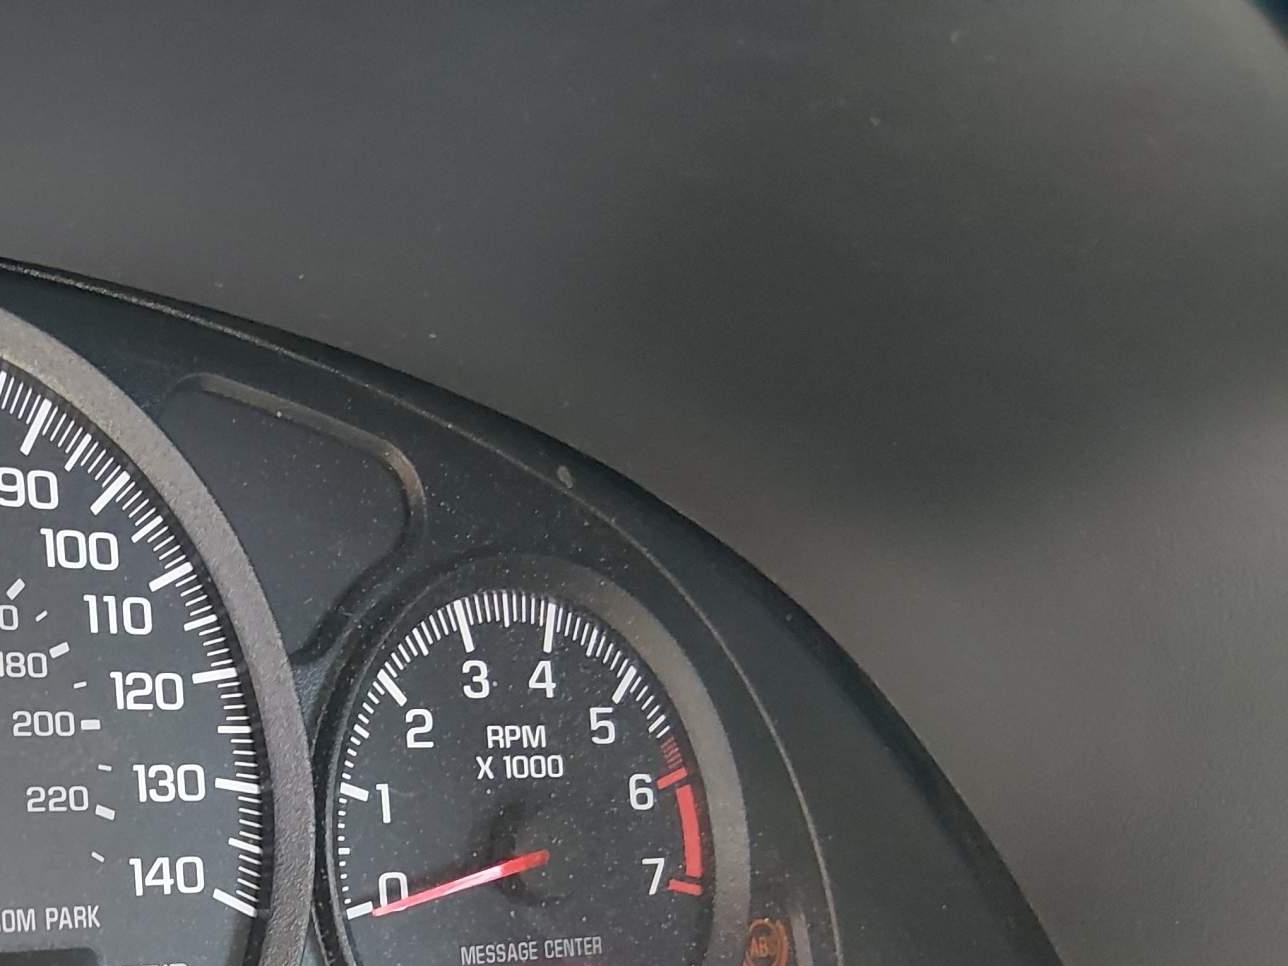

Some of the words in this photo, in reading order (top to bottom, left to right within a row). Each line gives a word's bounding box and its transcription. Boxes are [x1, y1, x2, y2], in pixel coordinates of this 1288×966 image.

[40, 528, 119, 571] 100
[83, 594, 153, 636] 110
[109, 671, 183, 711] 120
[462, 660, 490, 699] 3
[528, 660, 556, 699] 4
[12, 711, 75, 737] 200
[405, 709, 434, 748] 2
[486, 725, 547, 749] RPM
[589, 707, 616, 745] 5
[132, 763, 206, 803] 130
[477, 756, 494, 780] X
[503, 755, 564, 779] 1000
[26, 786, 89, 812] 220
[375, 783, 393, 824] 1
[628, 774, 654, 810] 6
[129, 856, 205, 896] 140
[378, 872, 409, 911] 0
[641, 858, 666, 895] 7
[46, 904, 101, 929] PARK
[460, 940, 538, 966] MESSAGE
[544, 936, 603, 958] CENTER
